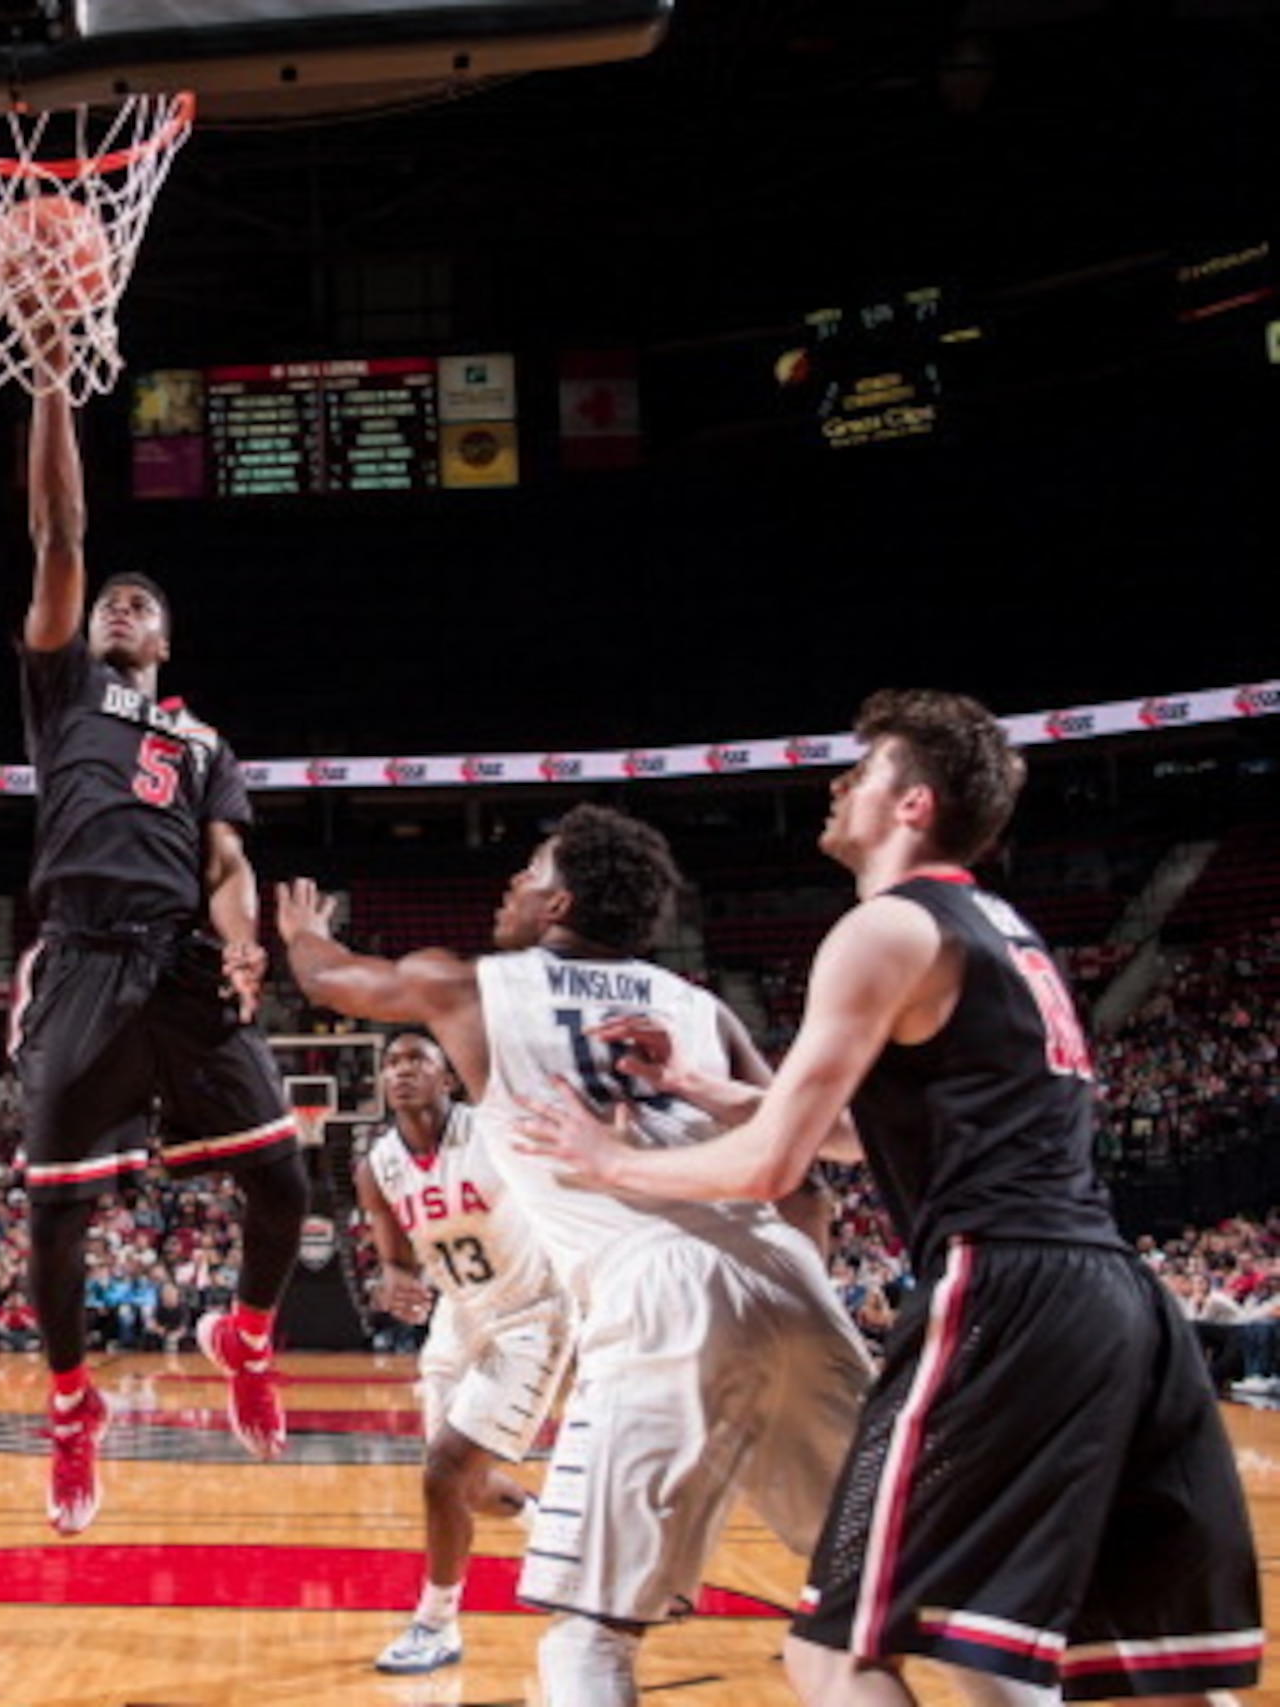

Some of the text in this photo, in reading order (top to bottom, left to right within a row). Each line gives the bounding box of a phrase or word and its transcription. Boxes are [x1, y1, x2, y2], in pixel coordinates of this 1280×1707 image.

[132, 732, 186, 808] 5
[546, 964, 652, 1006] WINSLOW
[398, 1181, 491, 1233] USA
[433, 1236, 496, 1287] 13
